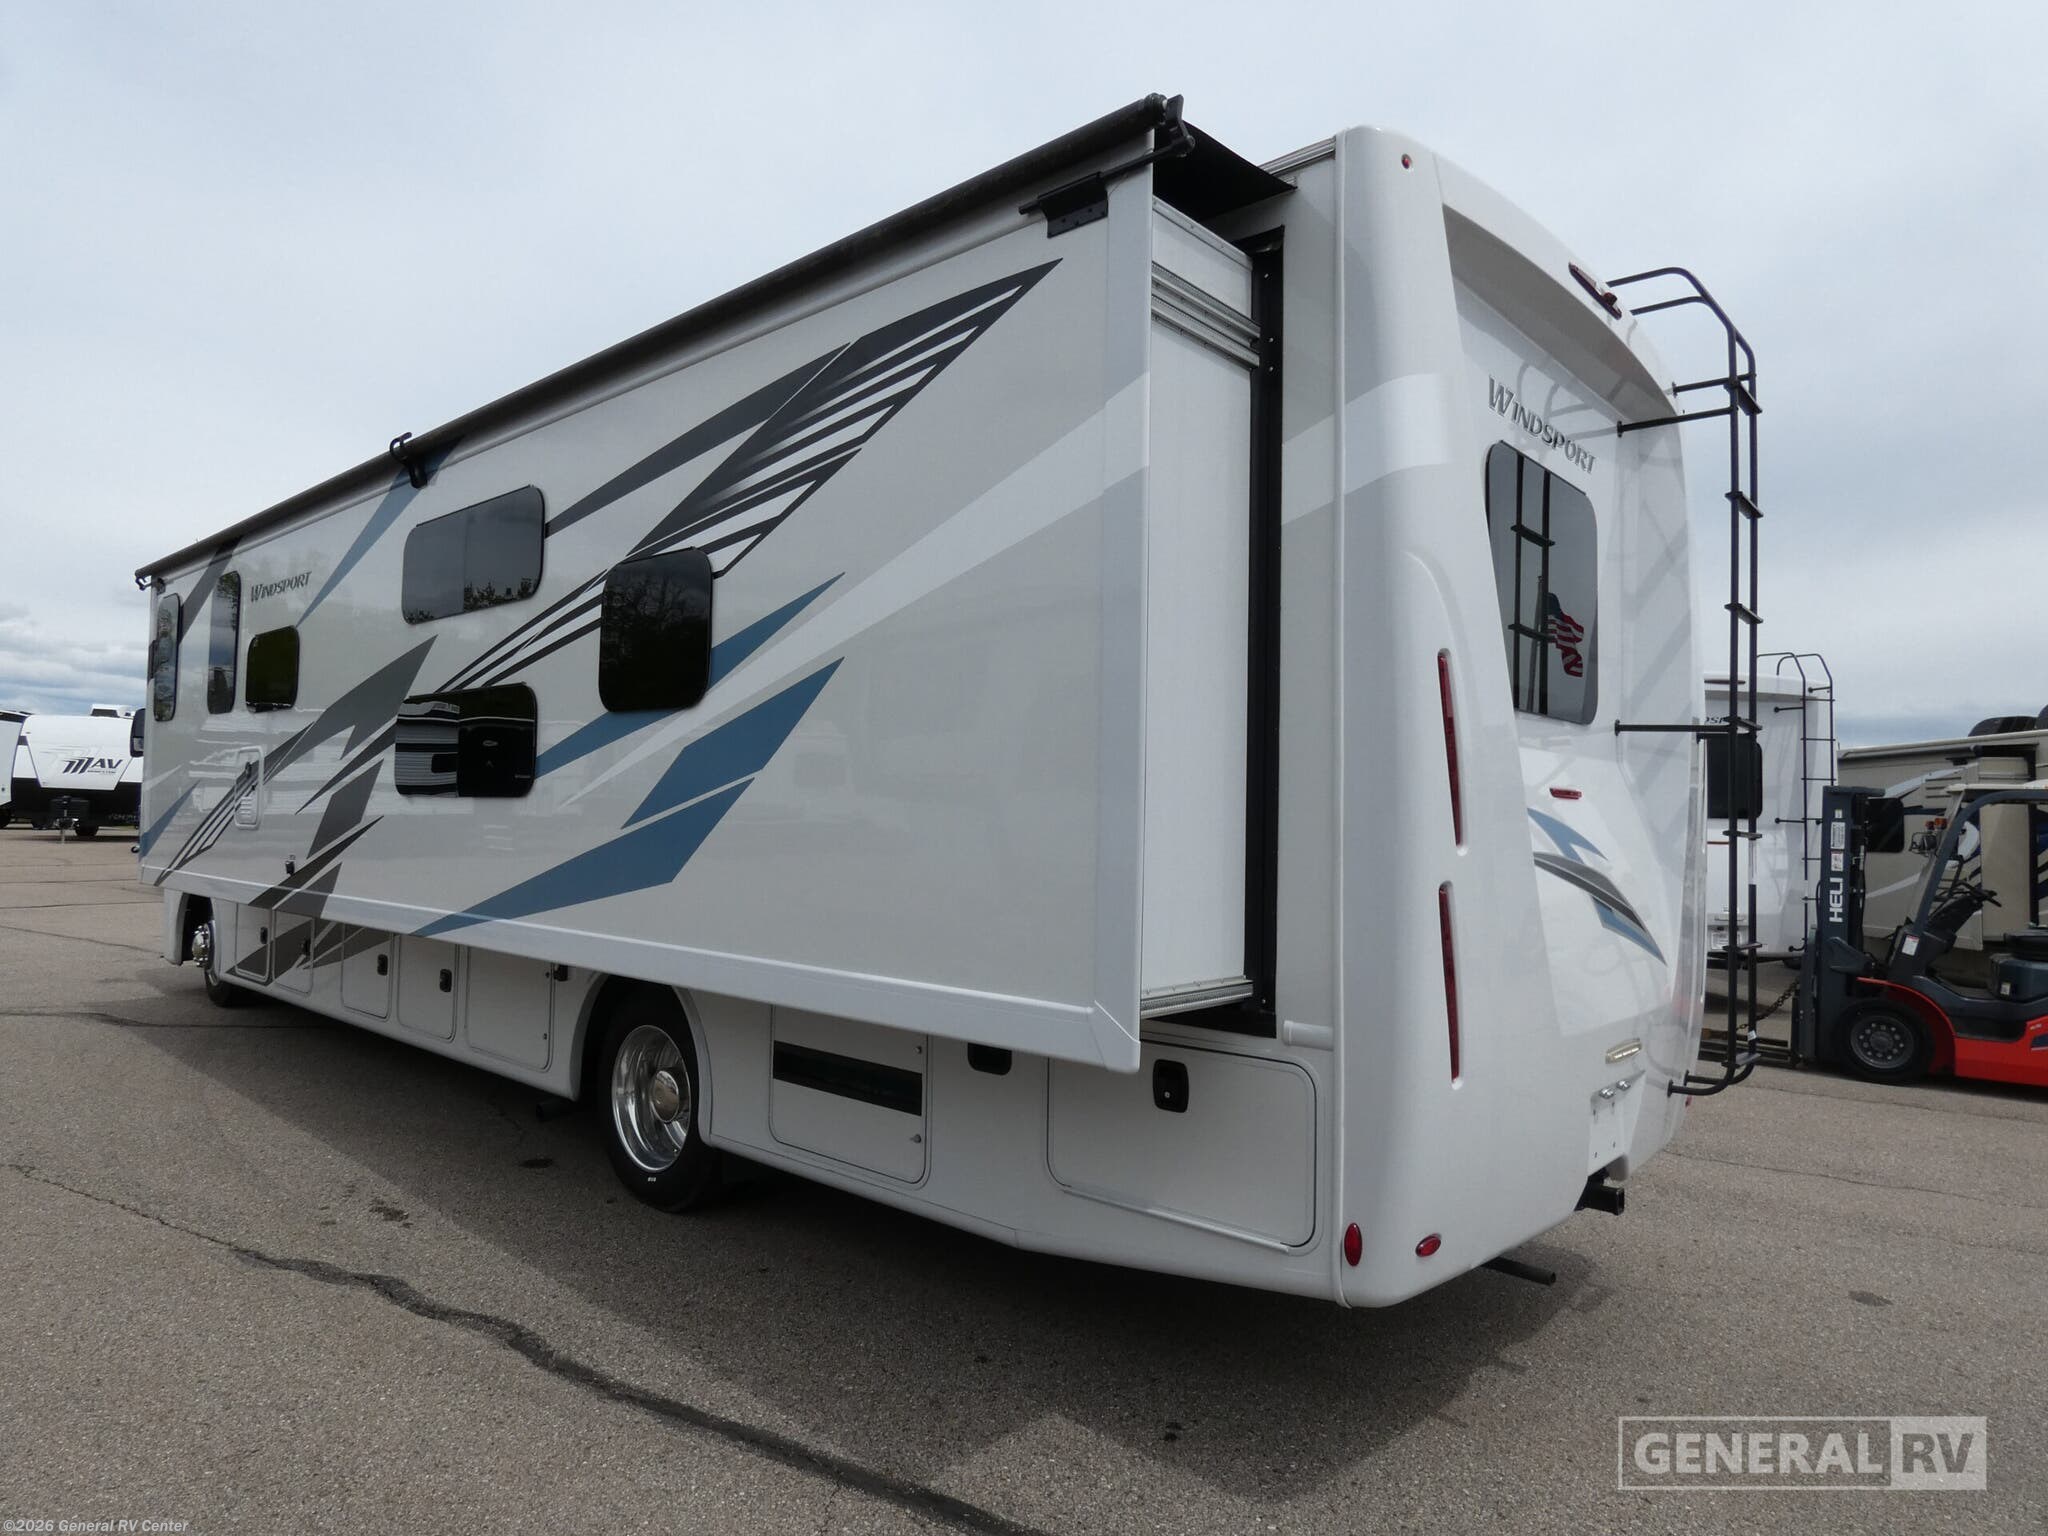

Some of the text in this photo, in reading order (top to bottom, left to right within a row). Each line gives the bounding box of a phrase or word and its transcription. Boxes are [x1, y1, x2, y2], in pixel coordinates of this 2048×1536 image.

[1489, 376, 1596, 474] WINDSPORT
[251, 571, 312, 602] WINDSPORT
[1829, 877, 1843, 922] HELI
